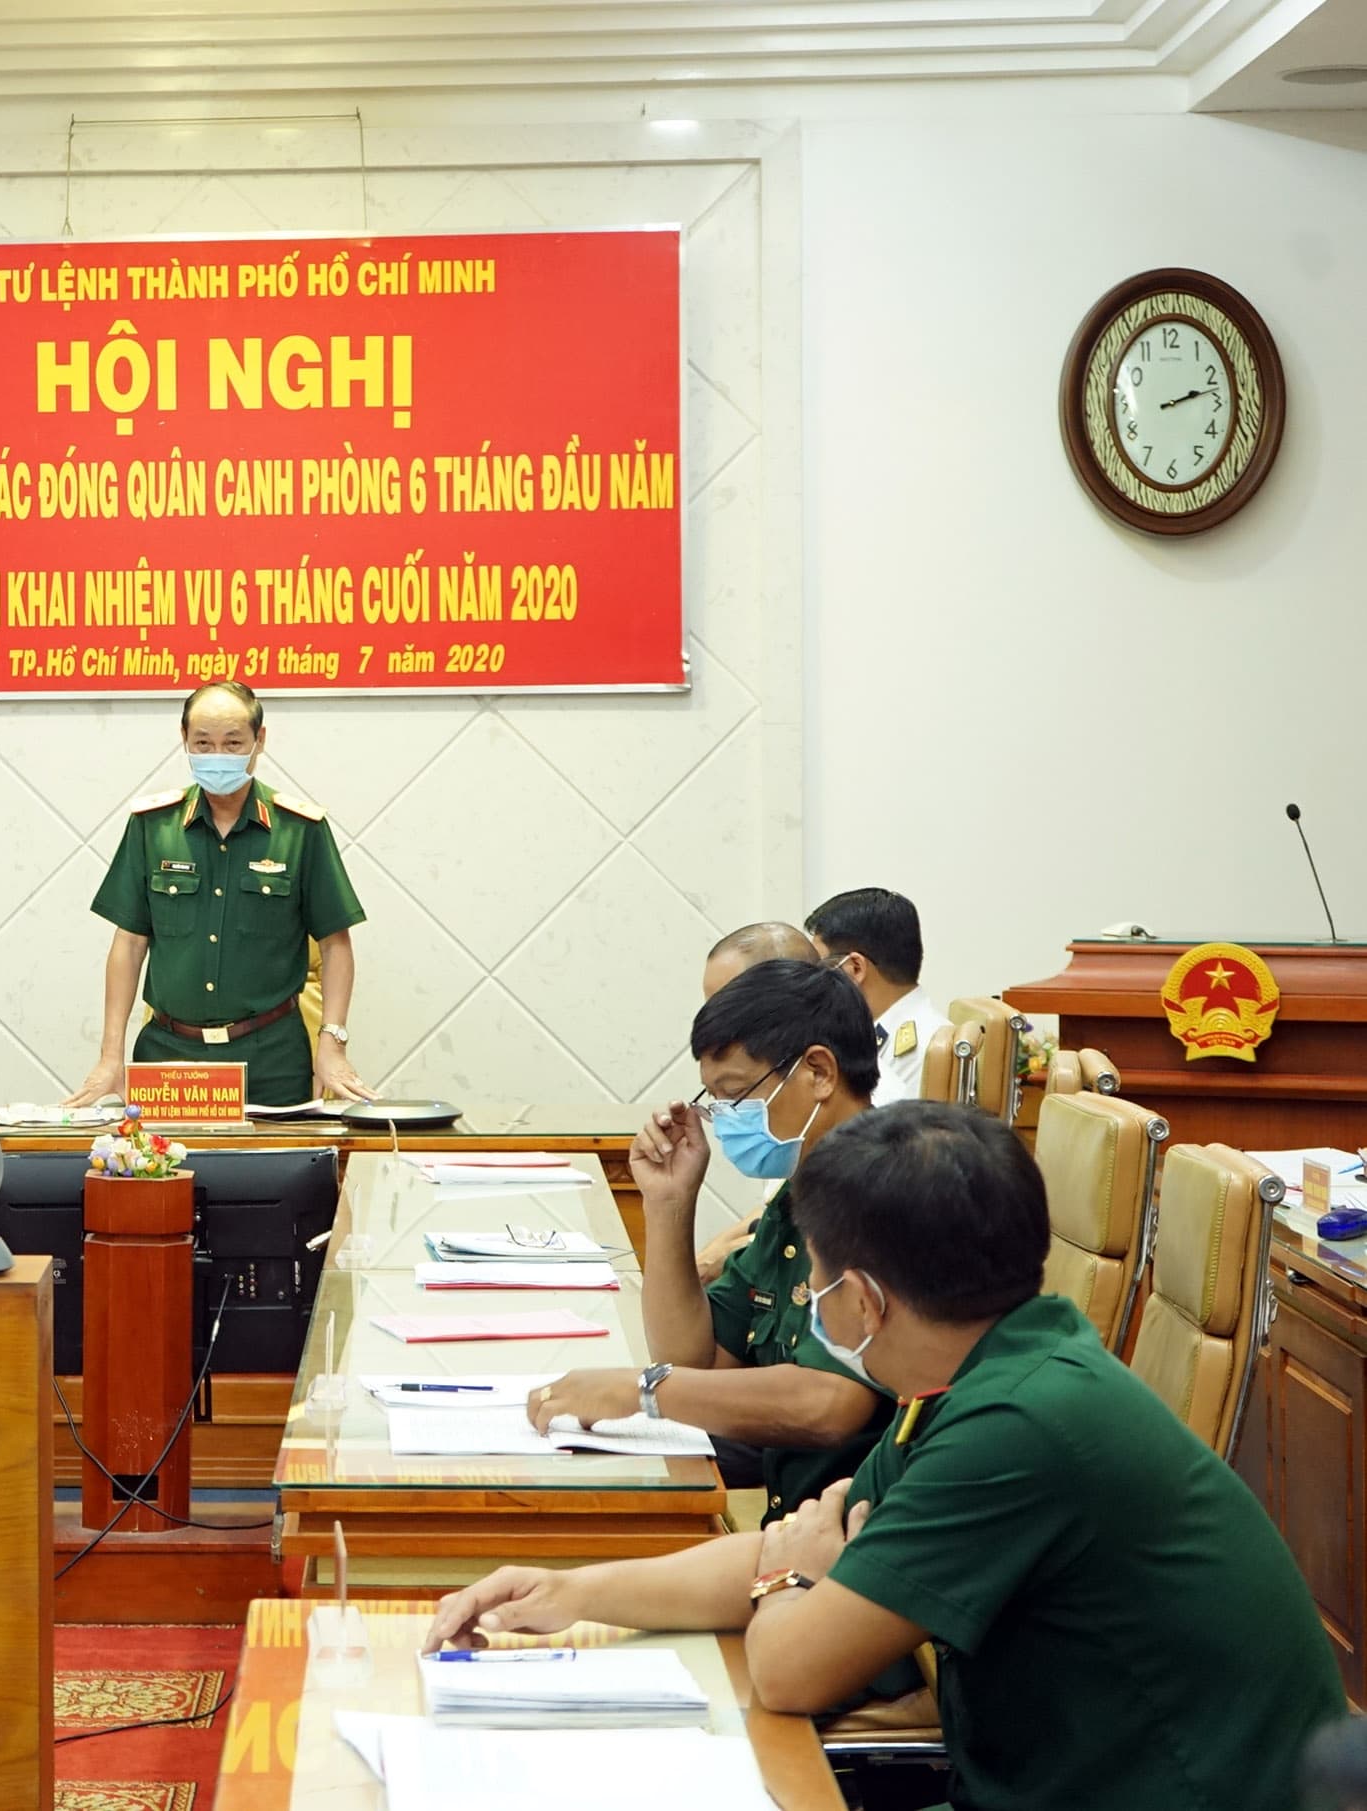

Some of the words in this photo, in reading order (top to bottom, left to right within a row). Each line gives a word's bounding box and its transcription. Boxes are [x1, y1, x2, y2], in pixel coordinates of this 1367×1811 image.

[41, 260, 119, 311] LỆNH
[127, 258, 229, 300] THÀNH
[238, 250, 300, 297] PHỐ
[308, 251, 350, 296] HỒ
[357, 252, 412, 296] CHÍ
[418, 259, 496, 294] MINH
[1163, 327, 1180, 348] 12
[1140, 341, 1151, 362] 11
[1194, 340, 1200, 361] 1
[36, 319, 178, 436] HỘI
[208, 334, 413, 429] NGHỊ
[1205, 365, 1218, 385] 2
[1212, 391, 1222, 412] 3
[1127, 420, 1138, 440] 8
[1204, 419, 1218, 439] 4
[1143, 446, 1153, 467] 7
[1193, 445, 1204, 466] 5
[38, 445, 118, 519] ĐÓNG
[127, 446, 206, 521] QUÂN
[215, 459, 294, 517] CANH
[301, 442, 401, 516] PHÒNG
[409, 457, 426, 514] 6
[434, 440, 534, 512] THÁNG
[541, 434, 601, 511] ĐẦU
[610, 439, 674, 509] NĂM
[1166, 459, 1178, 479] 6
[8, 570, 76, 626] KHAI
[84, 556, 176, 640] NHIỆM
[184, 569, 223, 640] VỤ
[231, 569, 248, 625] 6
[255, 553, 354, 624] THÁNG
[361, 549, 431, 624] CUỐI
[439, 551, 503, 622] NĂM
[511, 564, 578, 621] 2020
[82, 646, 120, 676] Chí
[123, 646, 181, 683] Minh,
[186, 645, 241, 682] ngày
[244, 646, 270, 676] 31
[277, 644, 340, 679] tháng
[358, 646, 374, 674] 7
[387, 643, 435, 673] năm
[444, 644, 506, 673] 2020
[130, 1082, 179, 1102] NGUYỄN
[183, 1084, 208, 1102] VĂN
[212, 1087, 239, 1102] NAM
